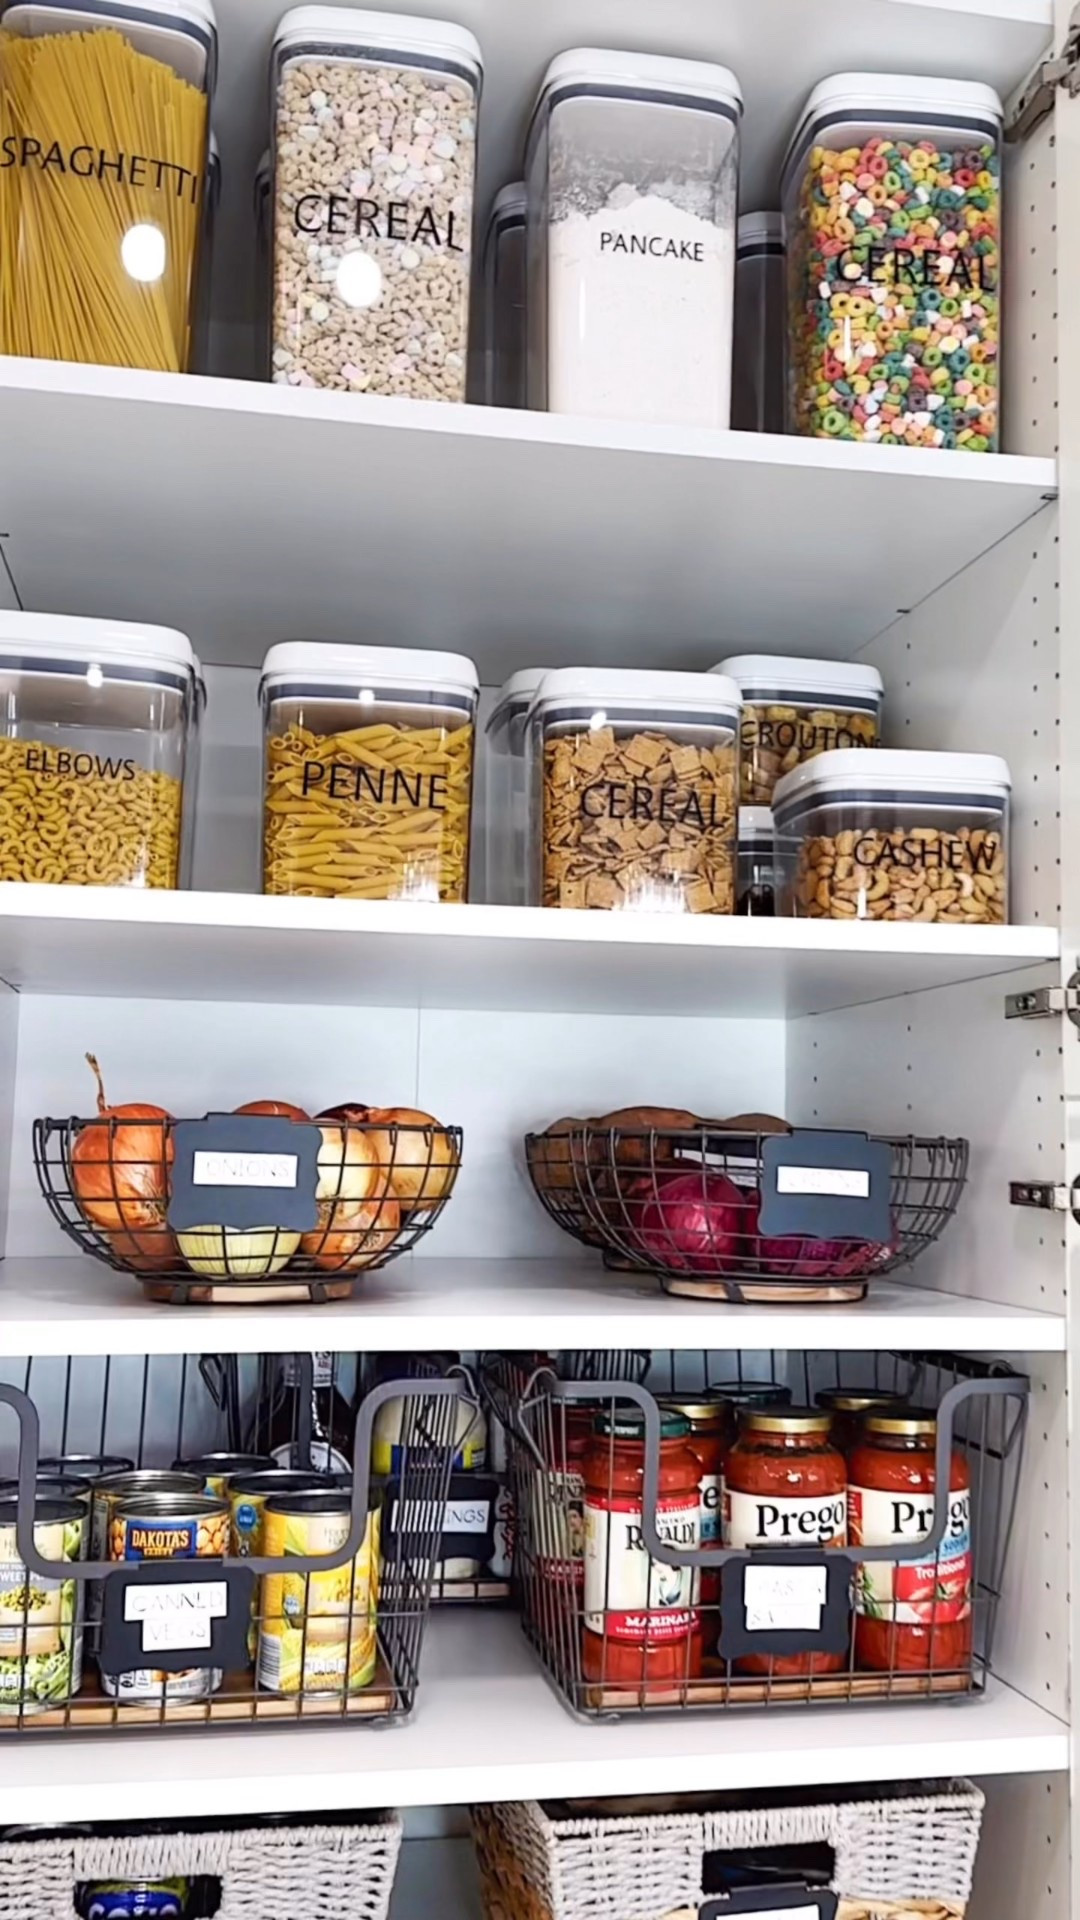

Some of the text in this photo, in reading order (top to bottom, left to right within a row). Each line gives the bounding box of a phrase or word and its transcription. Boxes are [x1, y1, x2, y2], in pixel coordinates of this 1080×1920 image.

[0, 136, 197, 204] SPAGHETTI
[294, 194, 464, 252] CEREAL
[600, 231, 704, 262] PANCAKE
[836, 245, 995, 292] CEREAL
[741, 720, 881, 749] CROUTON
[26, 748, 136, 781] ELBOWS
[301, 760, 448, 810] PENNE
[580, 783, 724, 828] CEREAL
[853, 837, 997, 873] CASHEW
[756, 1500, 845, 1543] Prego
